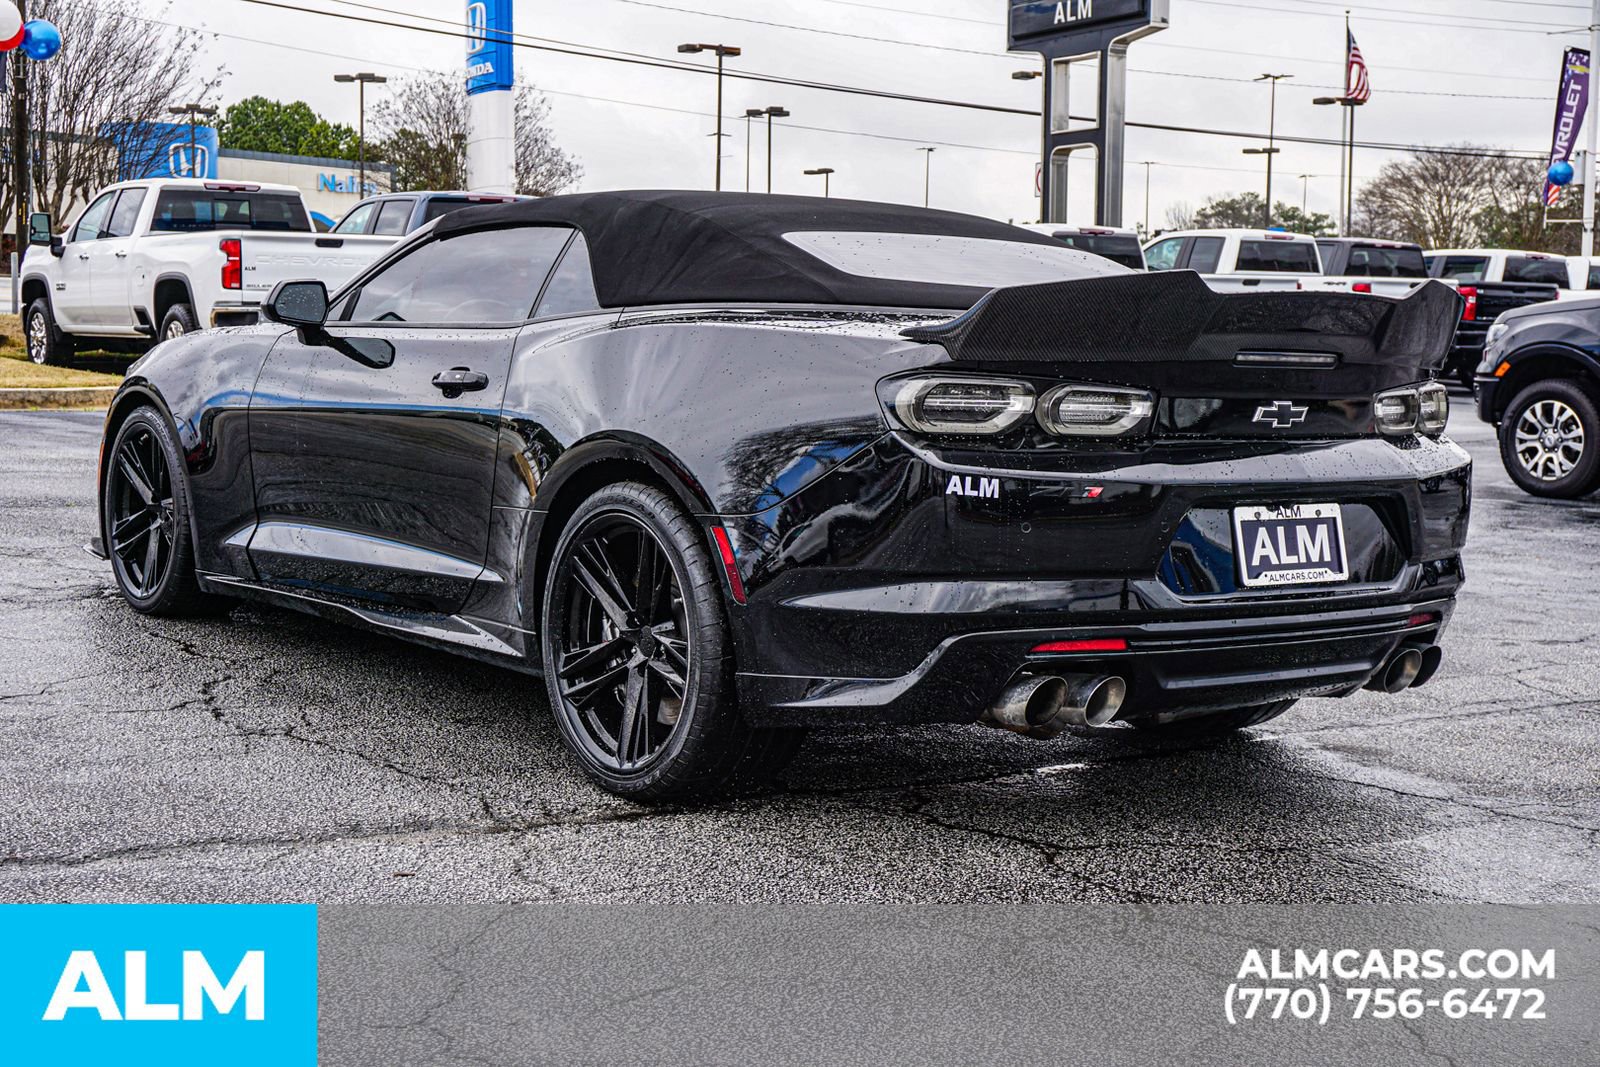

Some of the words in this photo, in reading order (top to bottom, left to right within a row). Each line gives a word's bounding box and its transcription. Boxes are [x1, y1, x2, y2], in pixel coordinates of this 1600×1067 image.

[1054, 0, 1092, 24] ALM
[1551, 80, 1582, 165] VROLET
[946, 475, 1000, 499] ALM
[1276, 505, 1302, 518] ALM
[1251, 524, 1332, 566] ALM
[1269, 571, 1325, 582] ALMCARS.COM
